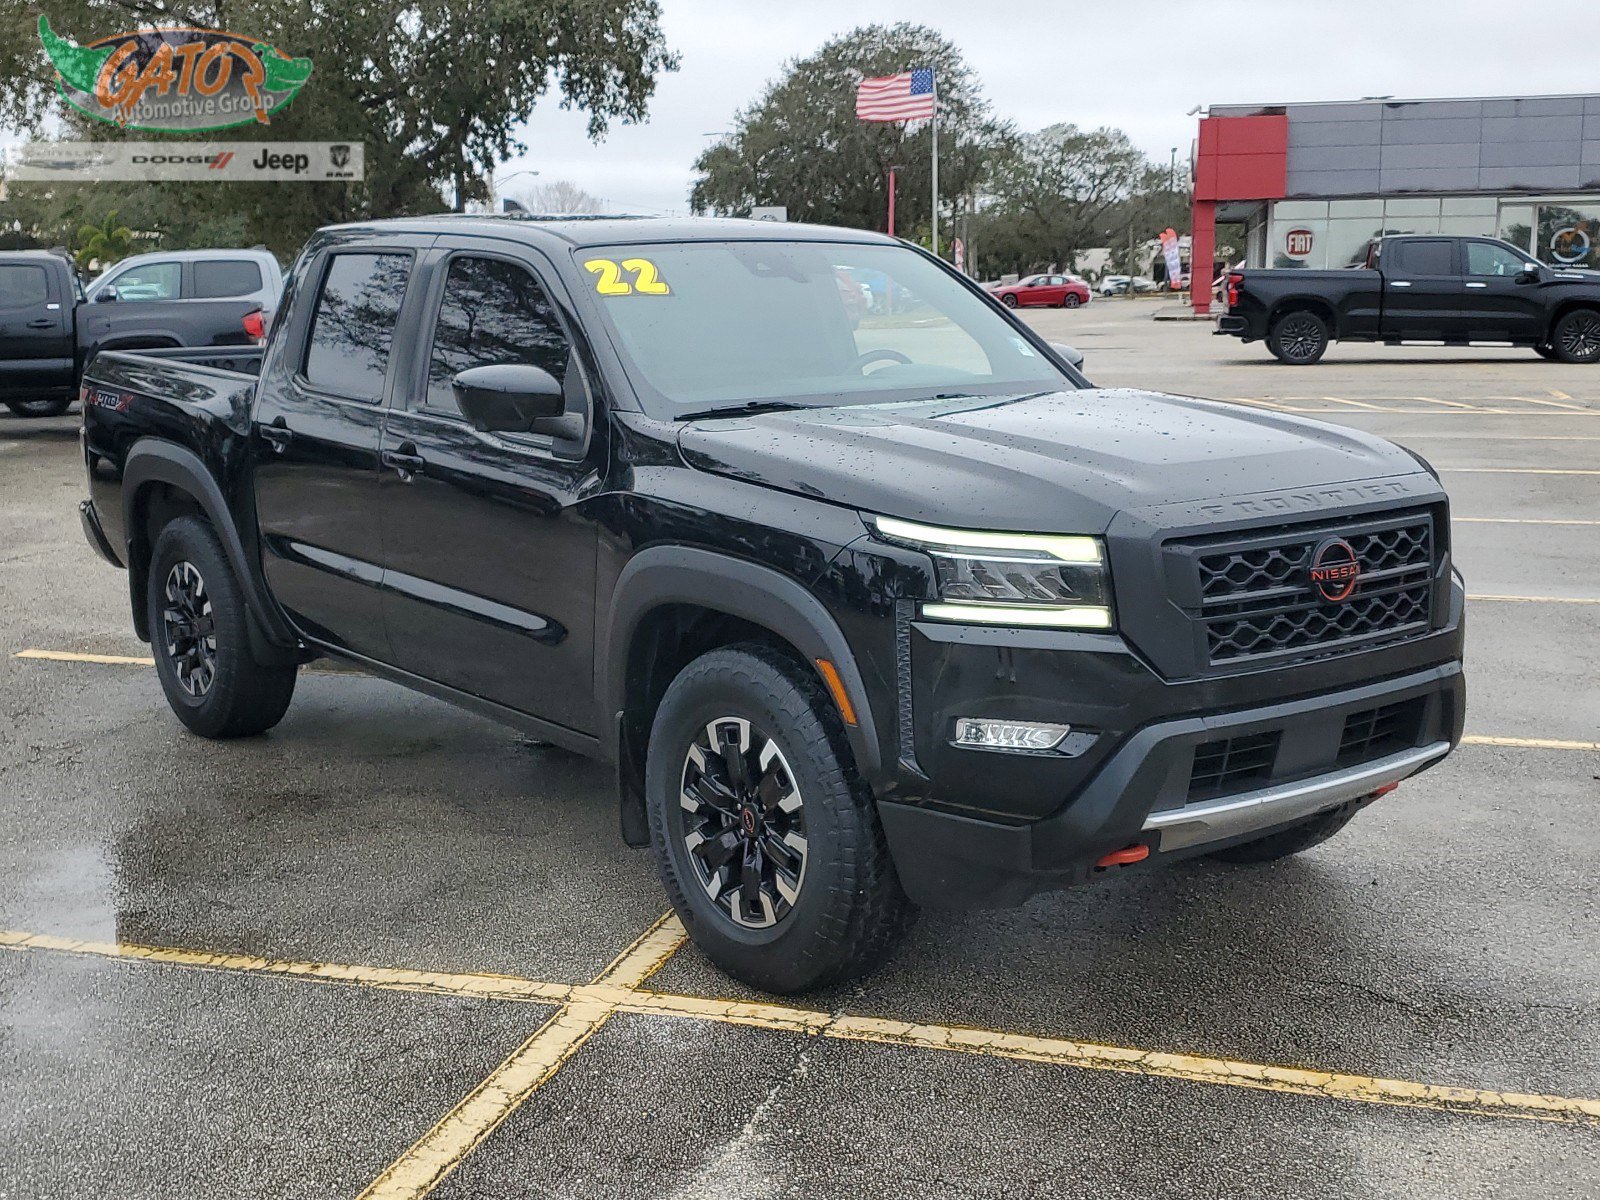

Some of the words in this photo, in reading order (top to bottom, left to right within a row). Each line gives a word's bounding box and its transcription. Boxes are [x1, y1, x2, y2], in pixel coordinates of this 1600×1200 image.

[1288, 233, 1312, 252] FIAT
[584, 258, 670, 295] 22
[1200, 482, 1410, 515] FRONTIER
